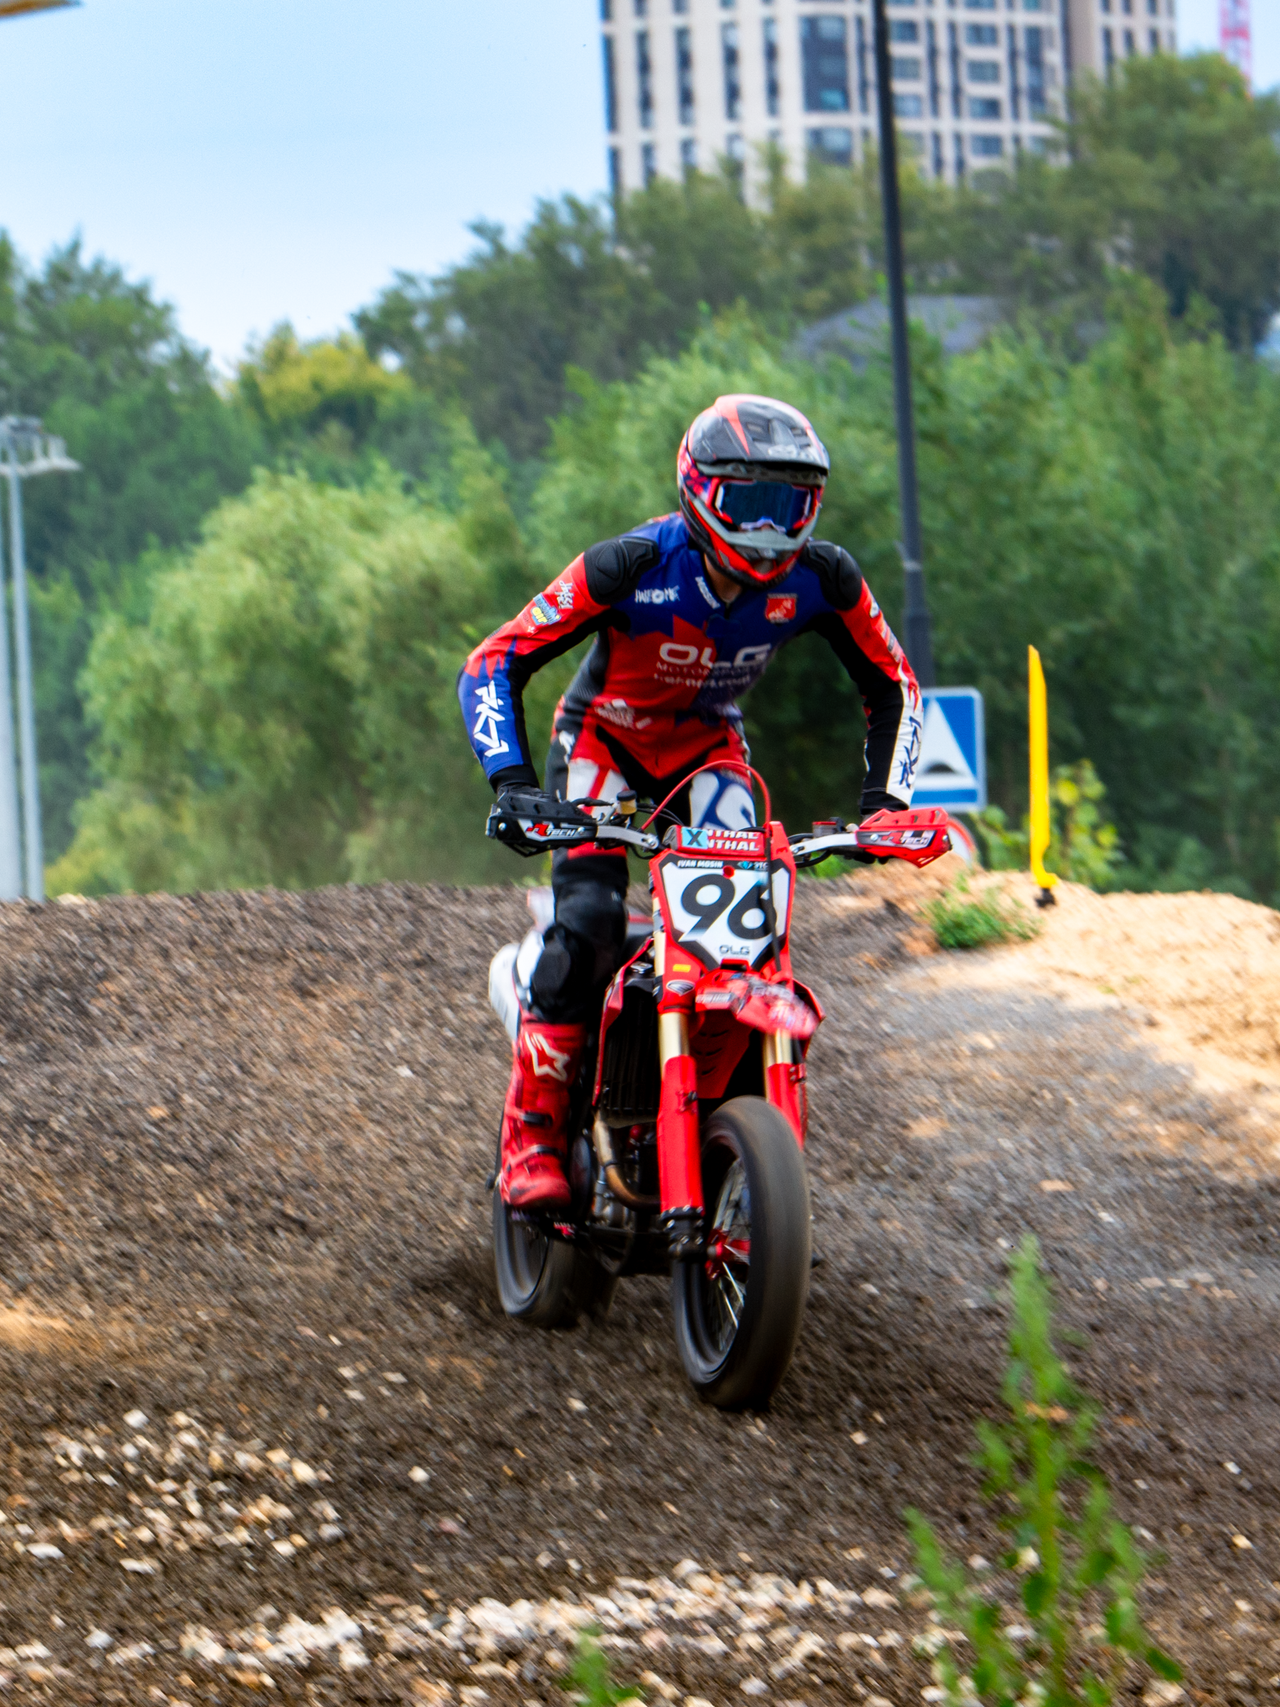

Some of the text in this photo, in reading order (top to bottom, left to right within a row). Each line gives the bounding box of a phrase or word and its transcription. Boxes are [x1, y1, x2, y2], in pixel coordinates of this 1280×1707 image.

[659, 642, 771, 667] OLG
[686, 829, 703, 847] X
[707, 829, 759, 840] NTHAL
[708, 839, 759, 851] NTHAL
[677, 860, 724, 868] IVAN MOSIN
[681, 873, 774, 941] 96
